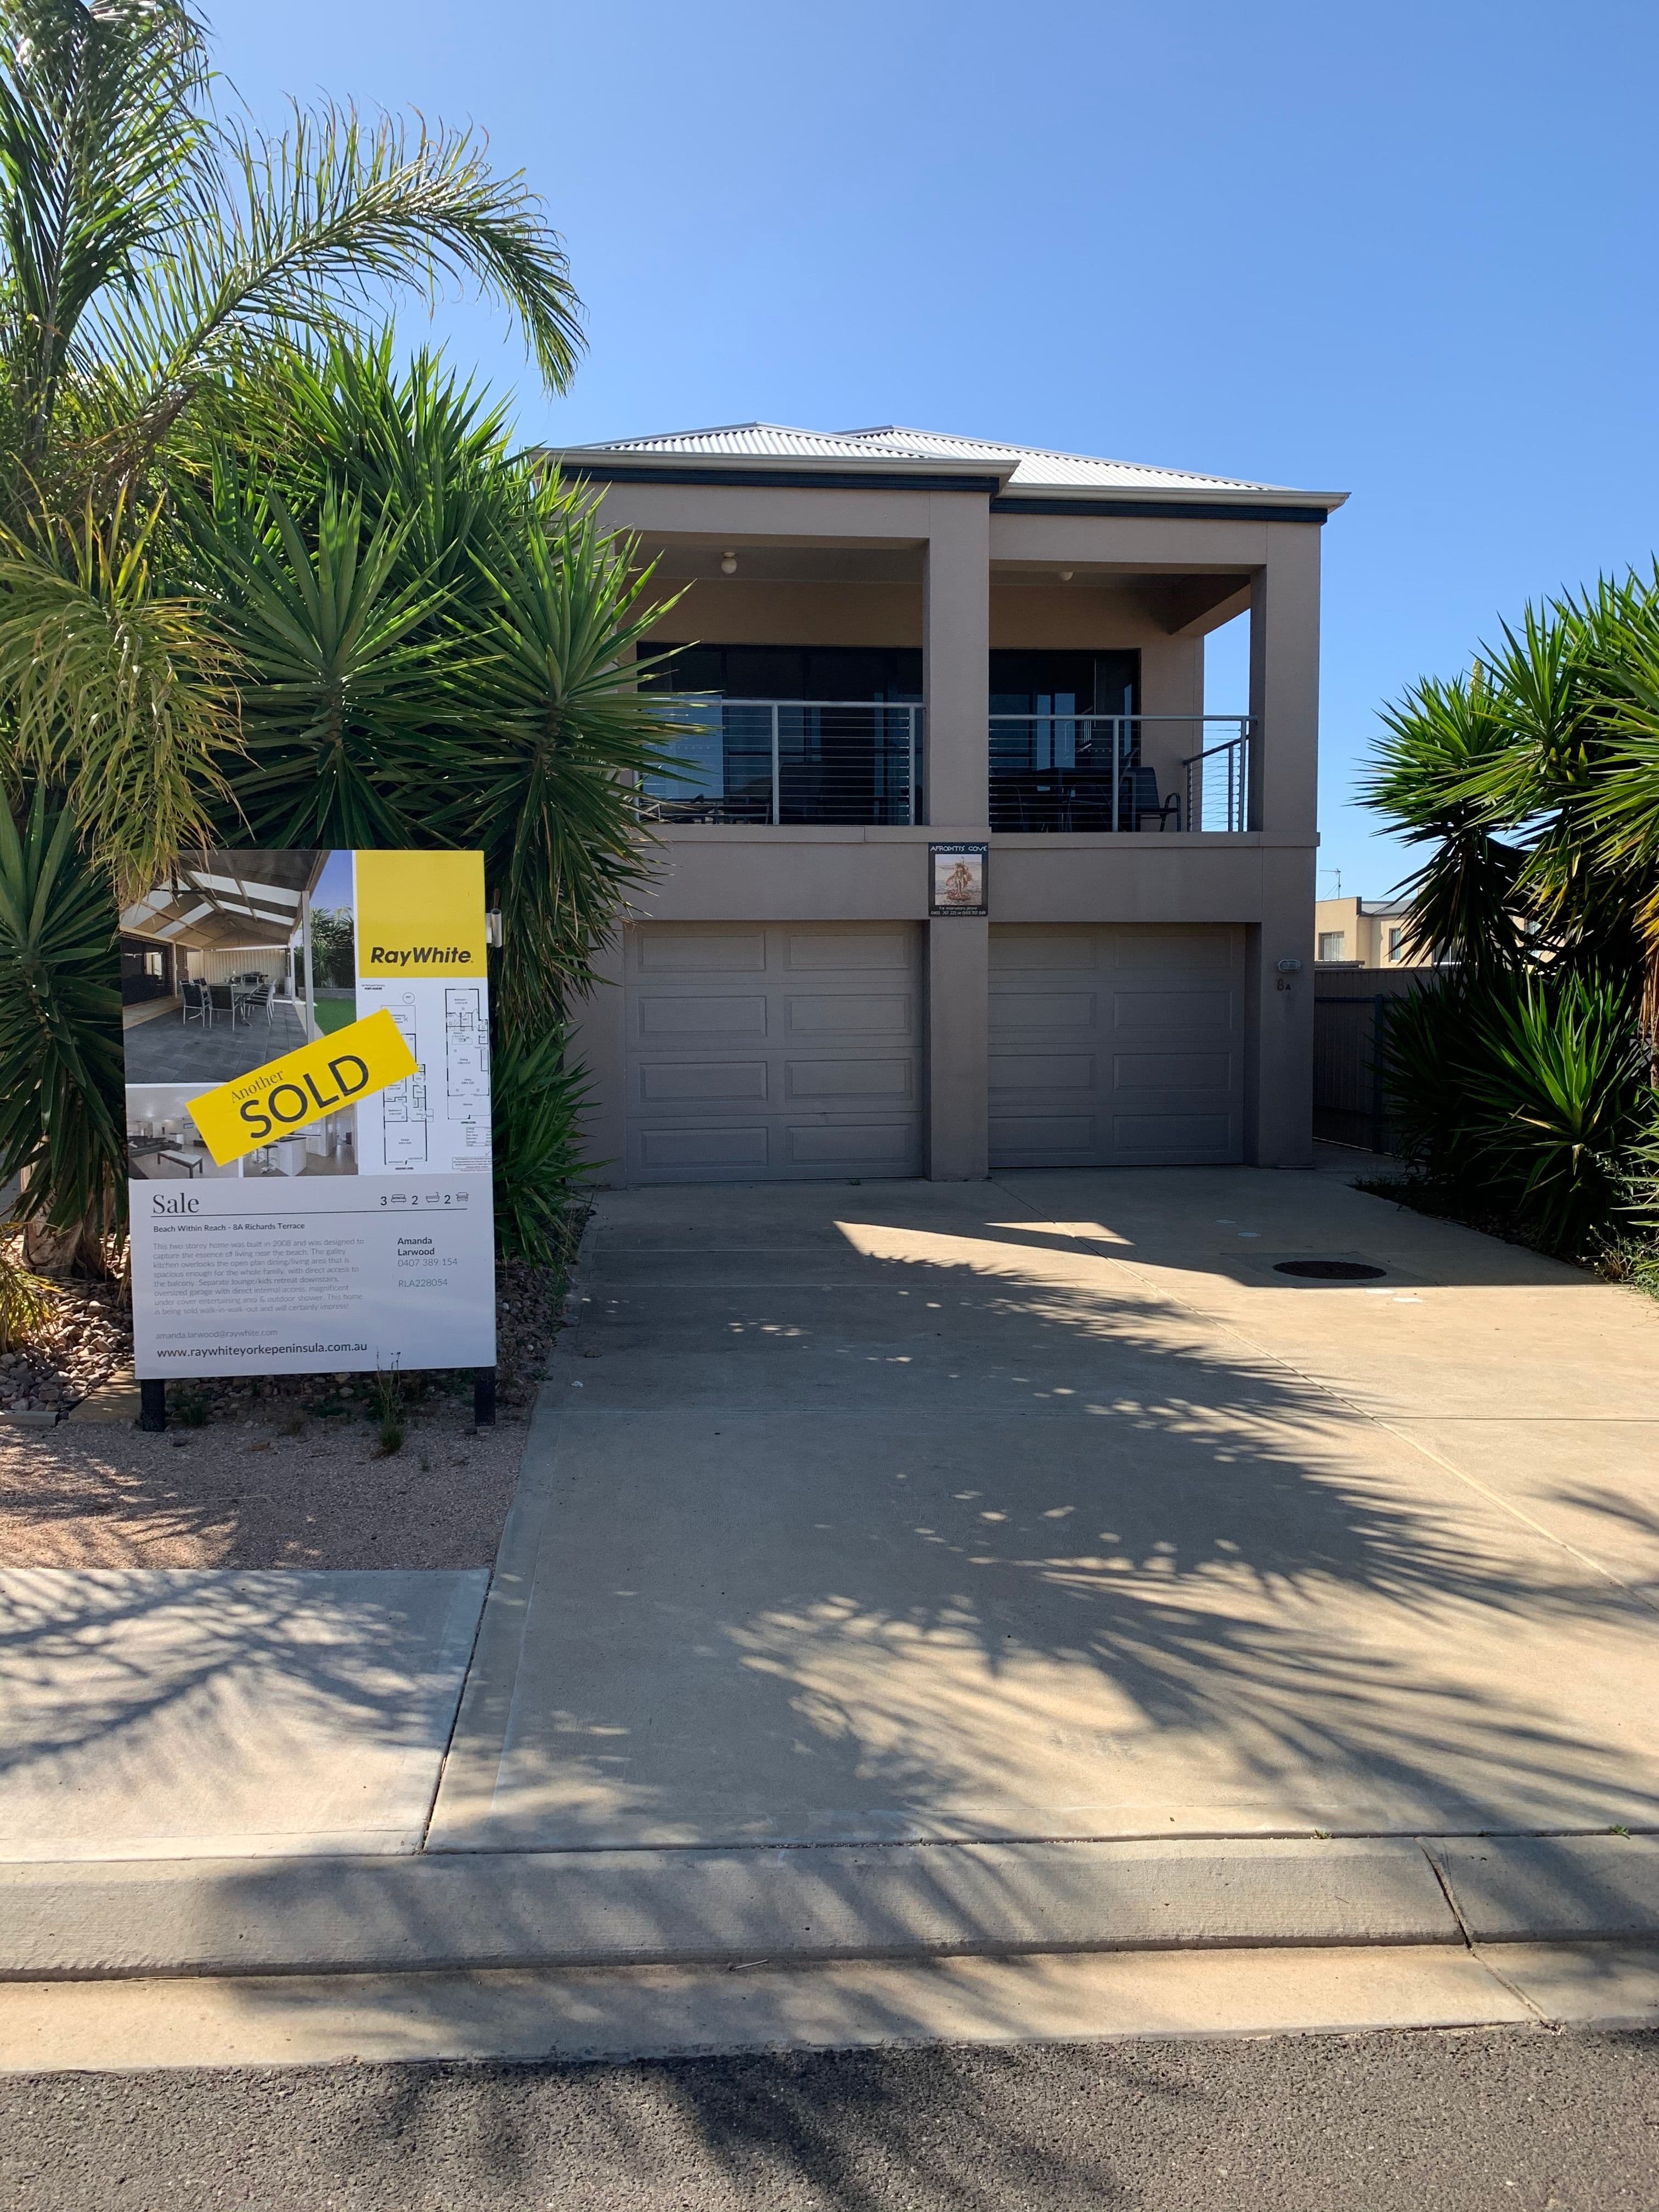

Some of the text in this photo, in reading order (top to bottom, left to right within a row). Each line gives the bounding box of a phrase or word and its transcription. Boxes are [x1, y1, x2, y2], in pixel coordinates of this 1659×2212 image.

[230, 1071, 283, 1103] Another
[240, 1055, 369, 1138] SOLD
[153, 1192, 200, 1214] Sale
[380, 1195, 451, 1205] 3 2 2
[398, 1248, 435, 1256] Larwood
[232, 1278, 272, 1286] lounge/kids
[398, 1279, 448, 1287] RLA228054
[156, 1329, 278, 1339] amanda.larwood@raywhite.com
[157, 1342, 367, 1358] www.raywhiteyorkepeninsula.com.au
